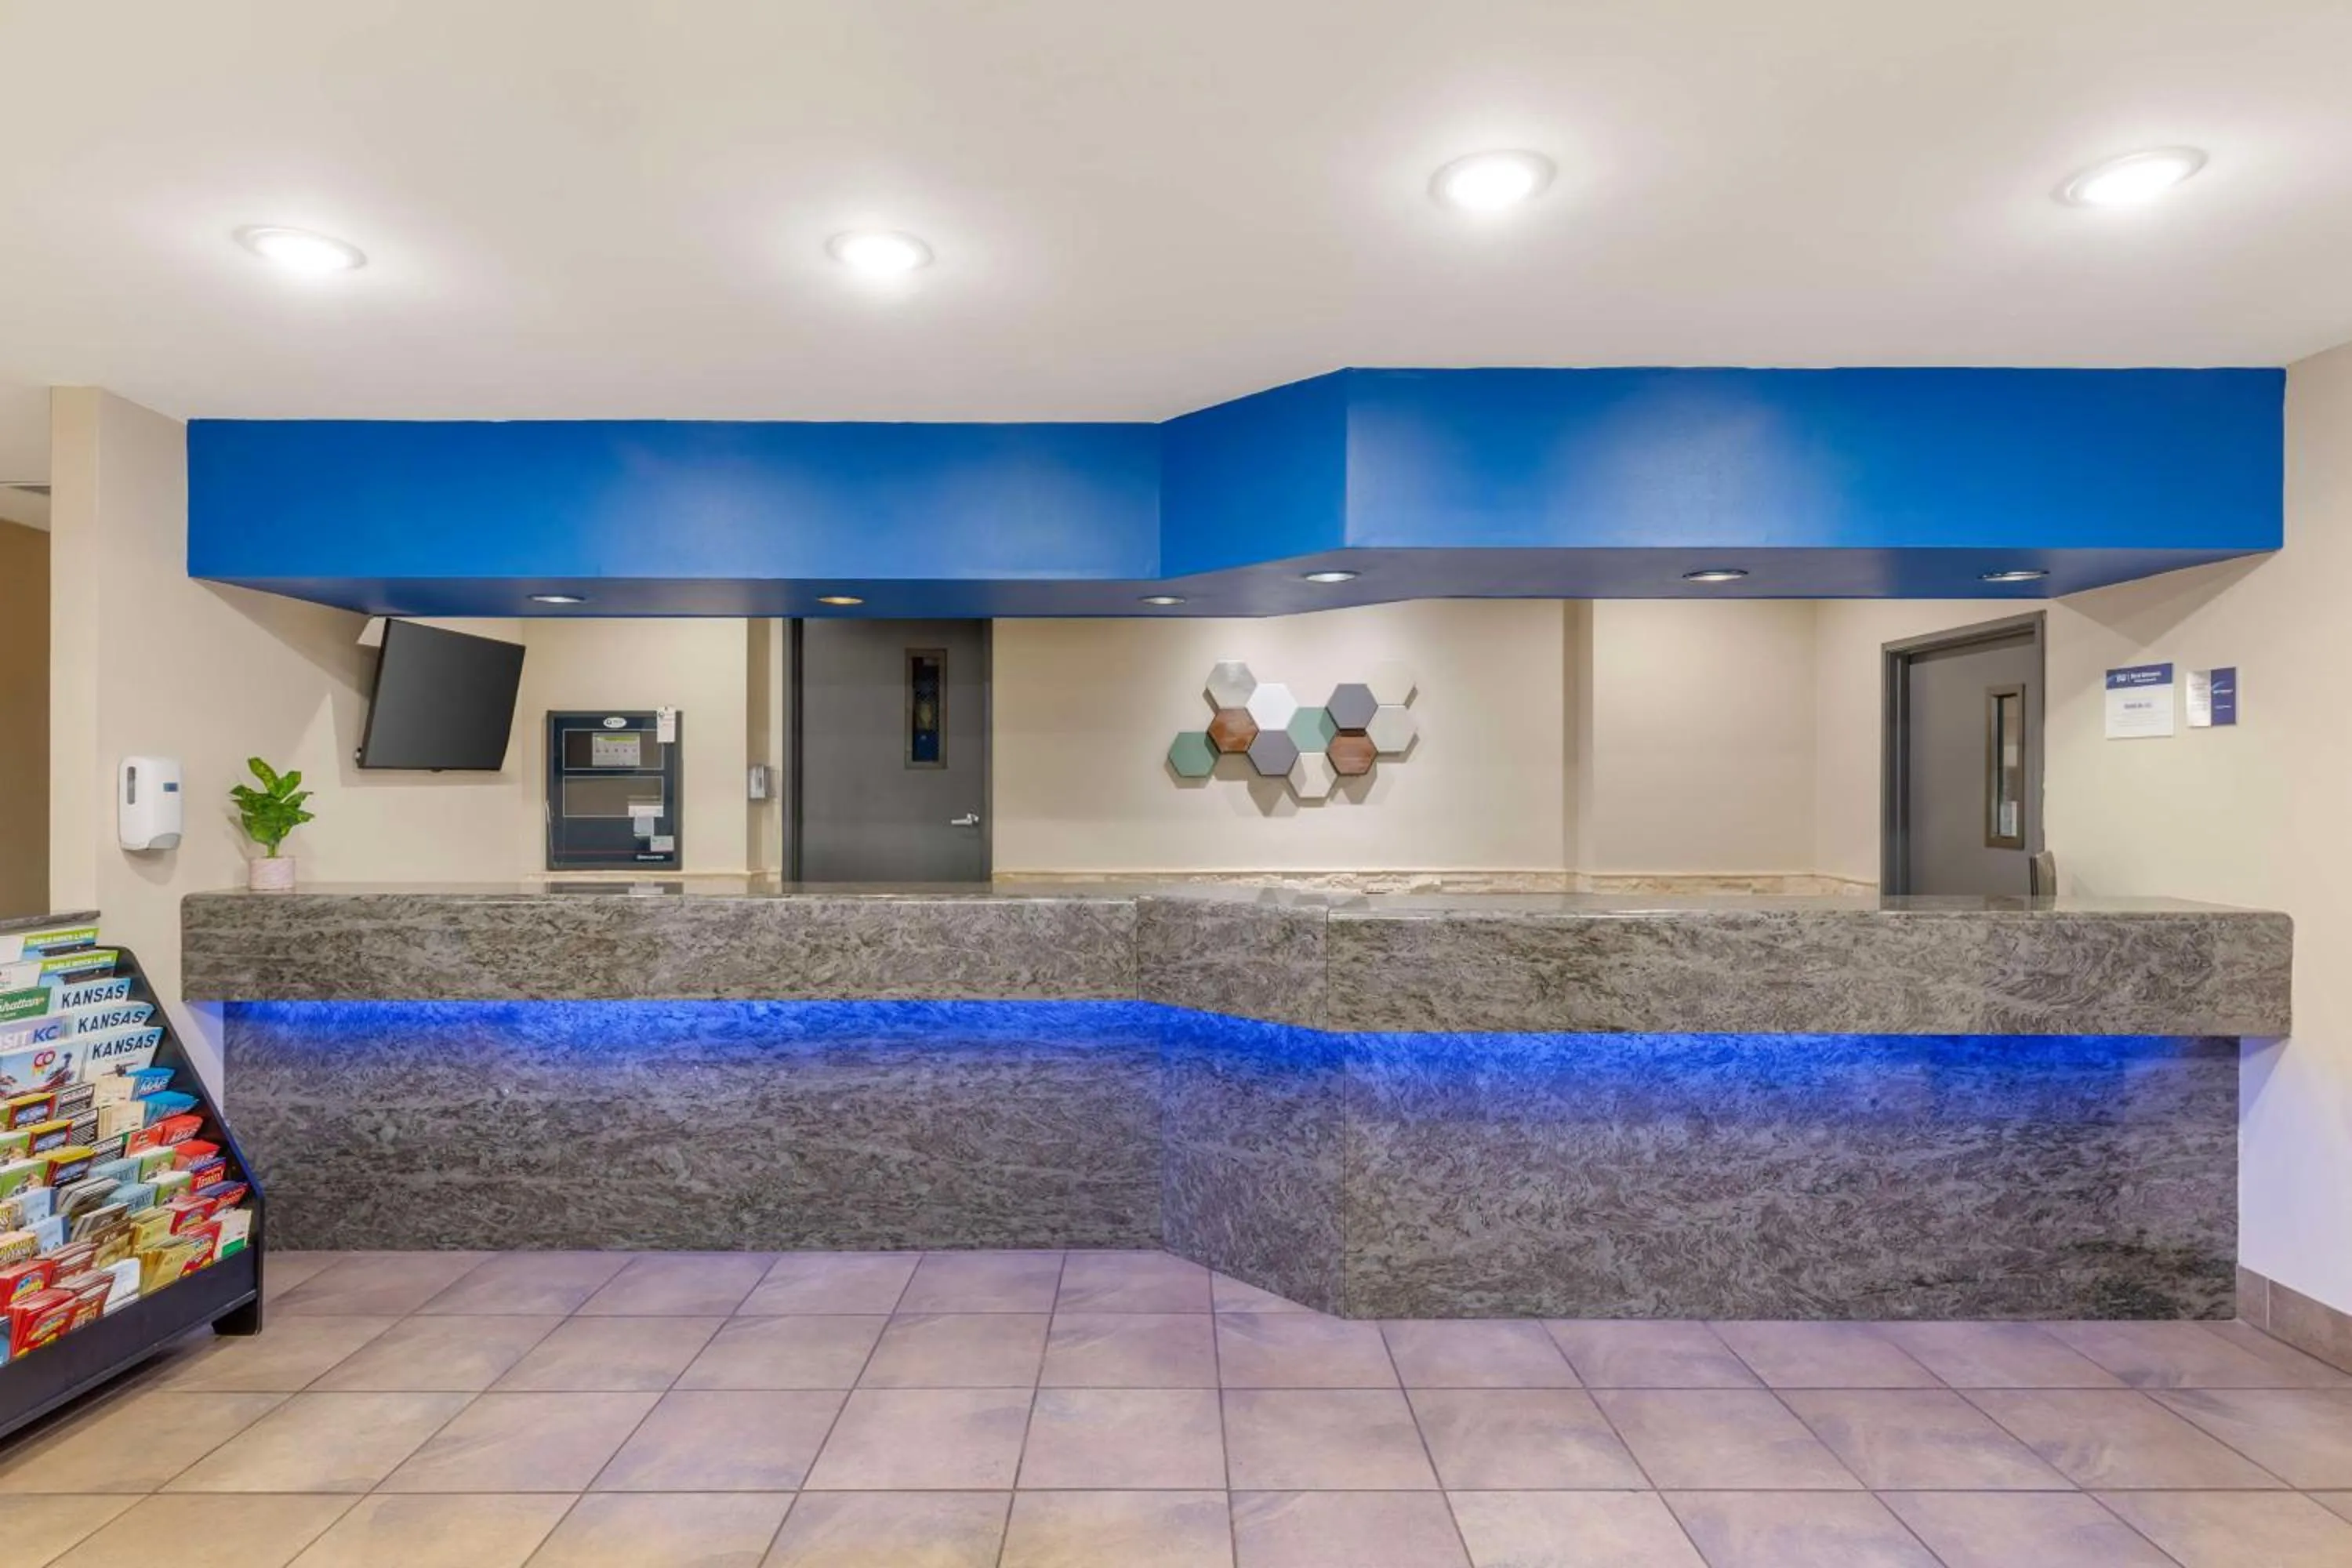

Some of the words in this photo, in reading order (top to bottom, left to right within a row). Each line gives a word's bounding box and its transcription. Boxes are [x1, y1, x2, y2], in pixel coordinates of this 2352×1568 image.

[62, 985, 125, 1009] KANSAS
[78, 1011, 147, 1034] KANSAS
[33, 1025, 60, 1044] KC
[93, 1033, 156, 1060] KANSAS
